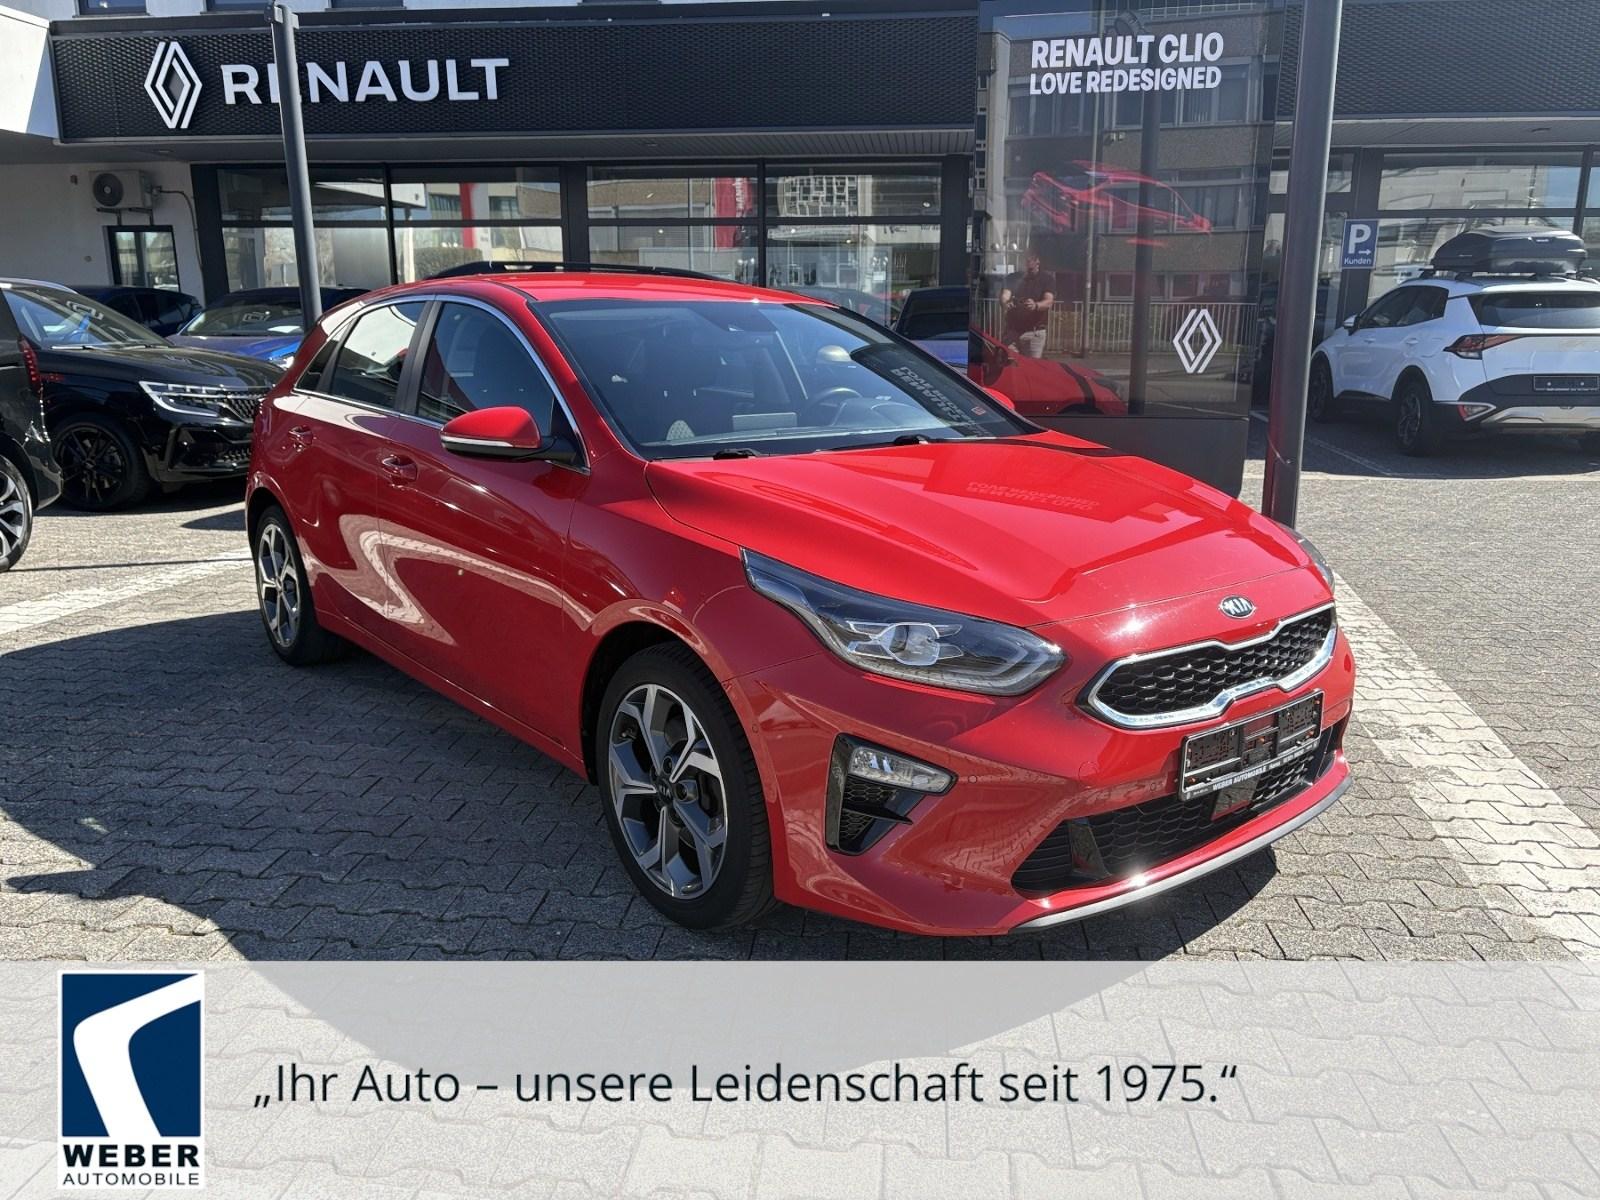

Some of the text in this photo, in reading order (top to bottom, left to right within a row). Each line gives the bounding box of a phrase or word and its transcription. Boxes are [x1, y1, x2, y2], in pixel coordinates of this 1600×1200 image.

[1031, 32, 1224, 69] RENAULT CLIO
[1029, 66, 1222, 95] LOVE REDESIGNED
[1348, 224, 1371, 254] P
[1344, 257, 1371, 265] Kunden
[1223, 597, 1253, 615] KIA
[1212, 765, 1267, 791] WEBER AUTOMOBILE
